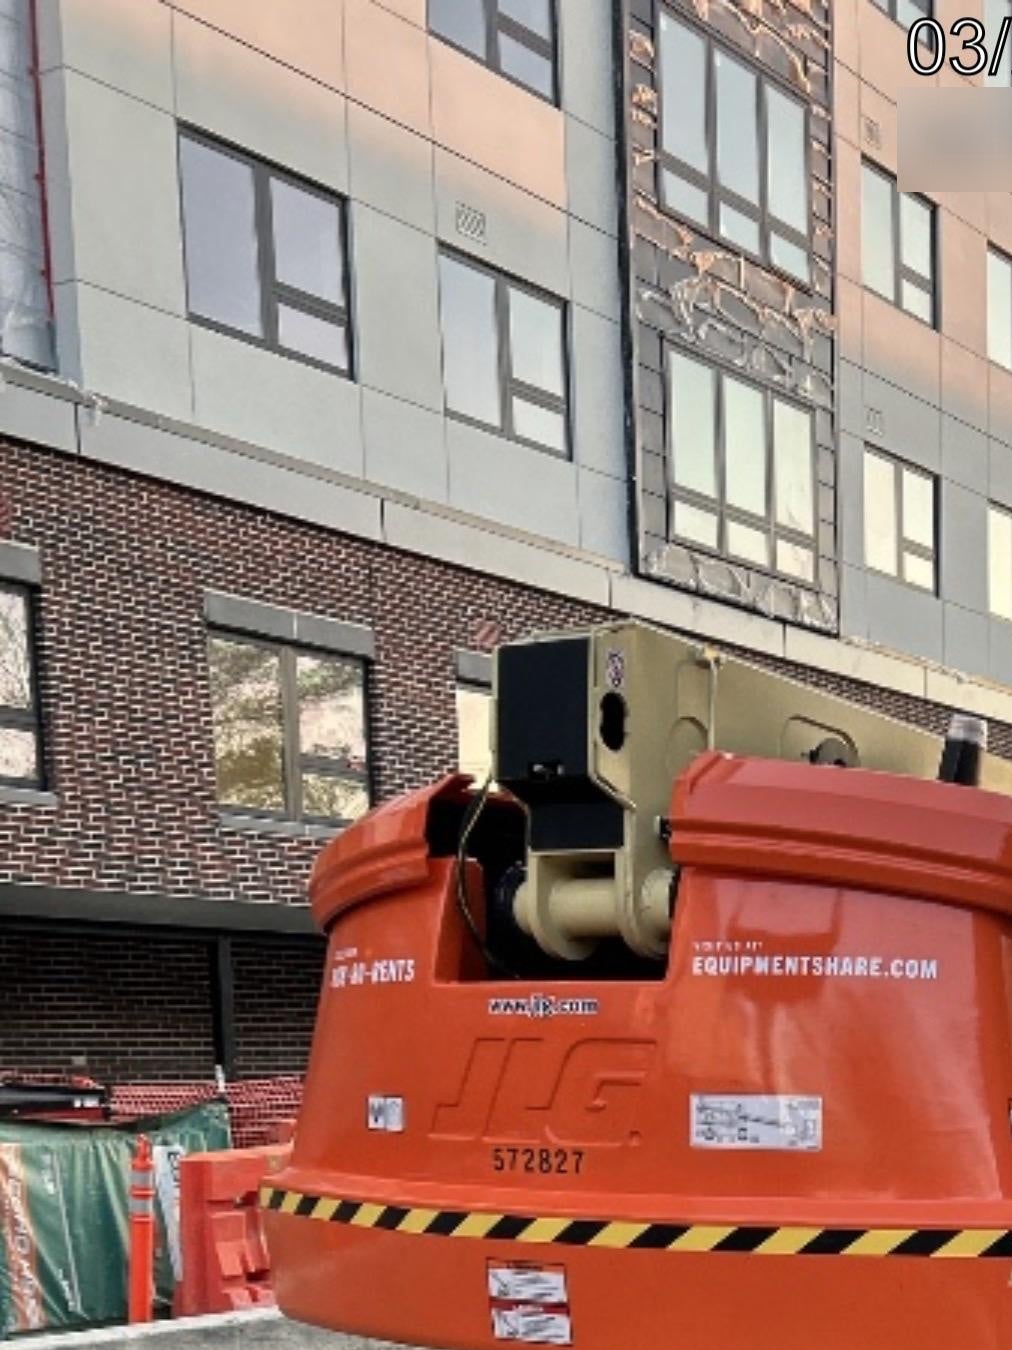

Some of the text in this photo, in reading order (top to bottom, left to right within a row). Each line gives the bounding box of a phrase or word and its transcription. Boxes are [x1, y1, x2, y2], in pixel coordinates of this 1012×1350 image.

[692, 956, 939, 979] EQUIPMENTSHARE.COM
[428, 1037, 657, 1147] JLG
[493, 1147, 585, 1174] 572827
